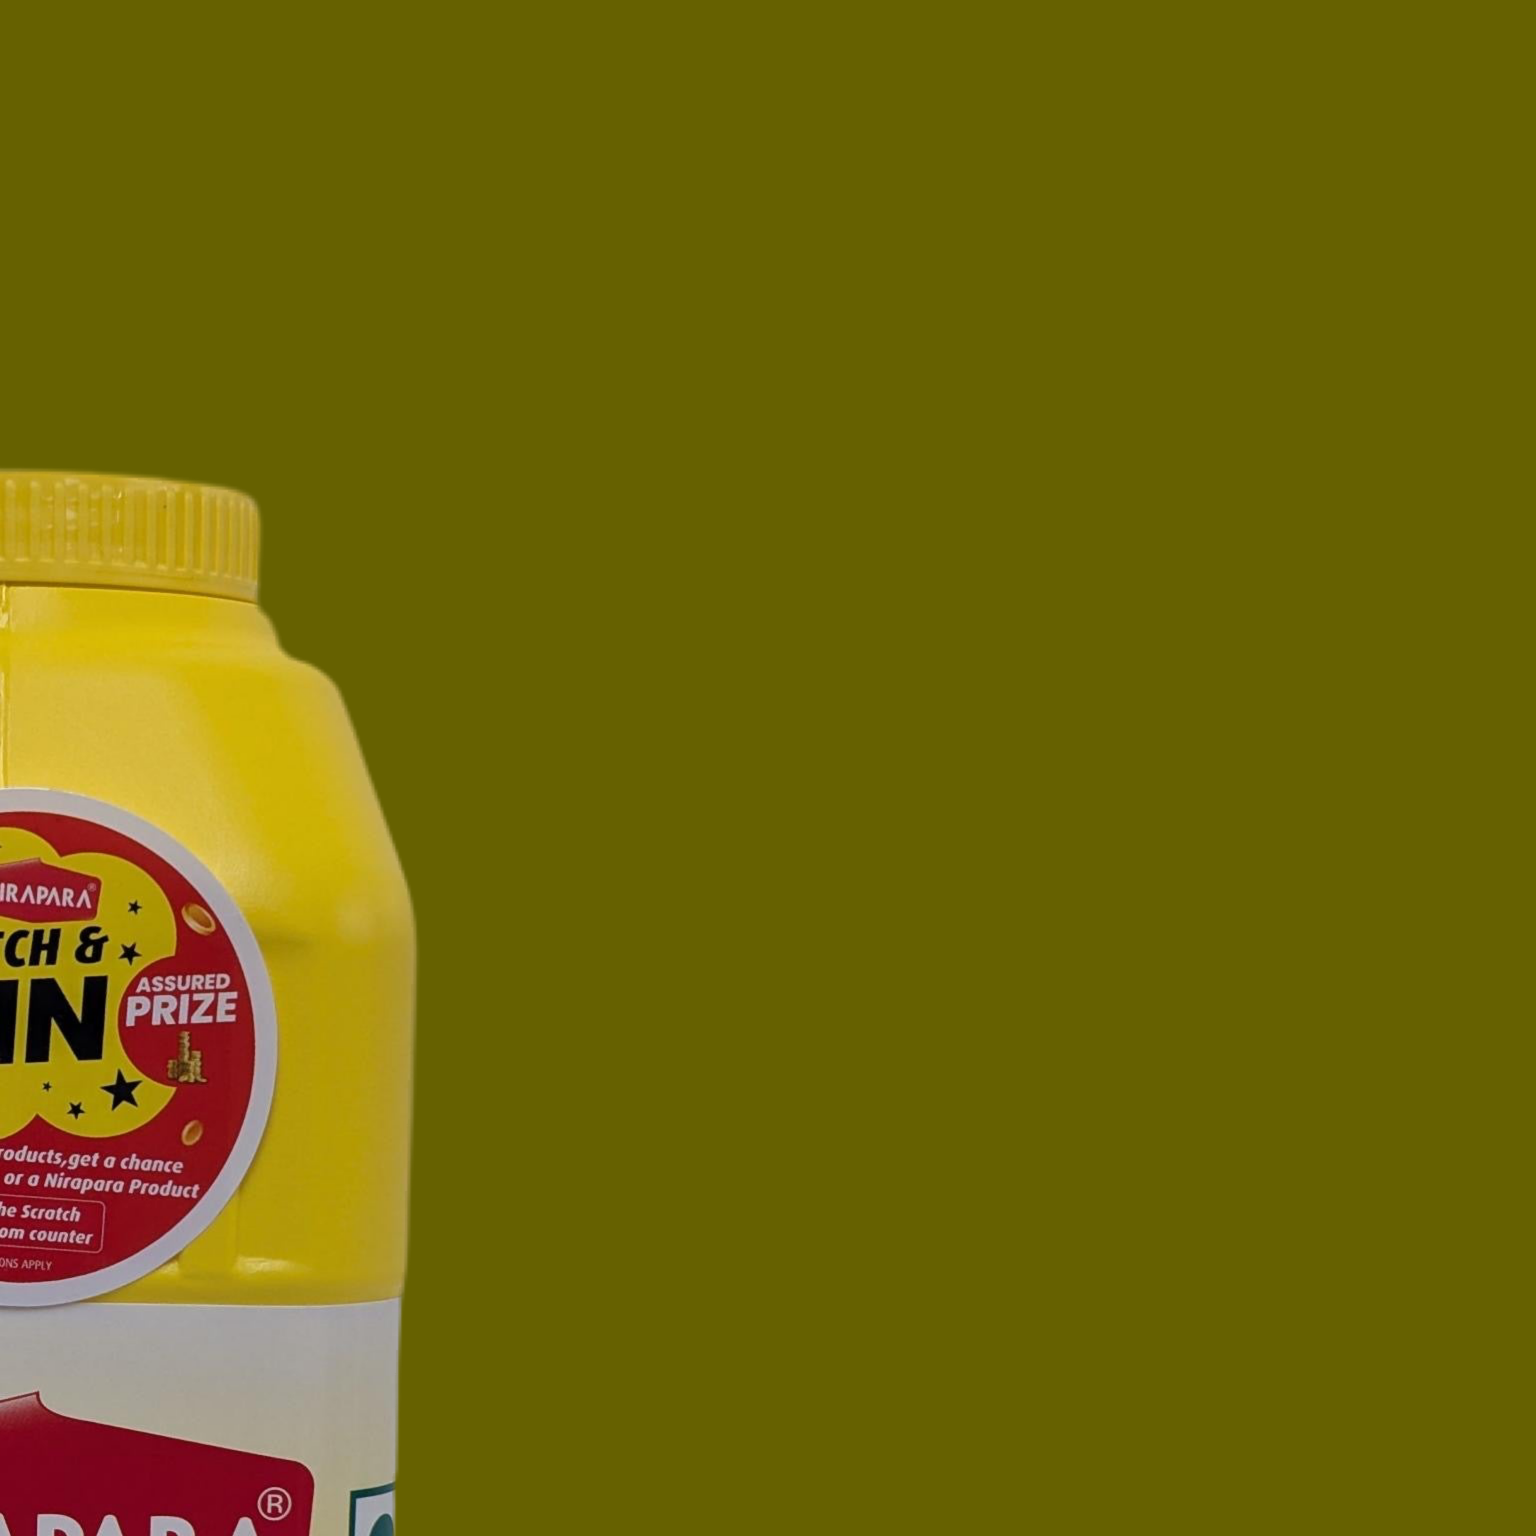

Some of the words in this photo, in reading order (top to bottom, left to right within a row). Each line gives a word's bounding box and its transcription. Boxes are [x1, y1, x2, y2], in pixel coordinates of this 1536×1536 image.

[74, 926, 110, 964] &
[136, 973, 230, 994] ASSURED
[125, 991, 238, 1027] PRIZE
[104, 1156, 116, 1169] a
[120, 1154, 184, 1174] chance
[4, 1171, 22, 1186] or
[27, 1173, 39, 1187] a
[44, 1173, 124, 1196] Nirapara
[129, 1178, 201, 1200] Product
[21, 1203, 81, 1223] Scratch
[29, 1226, 94, 1246] counter
[21, 1258, 52, 1272] APPLY
